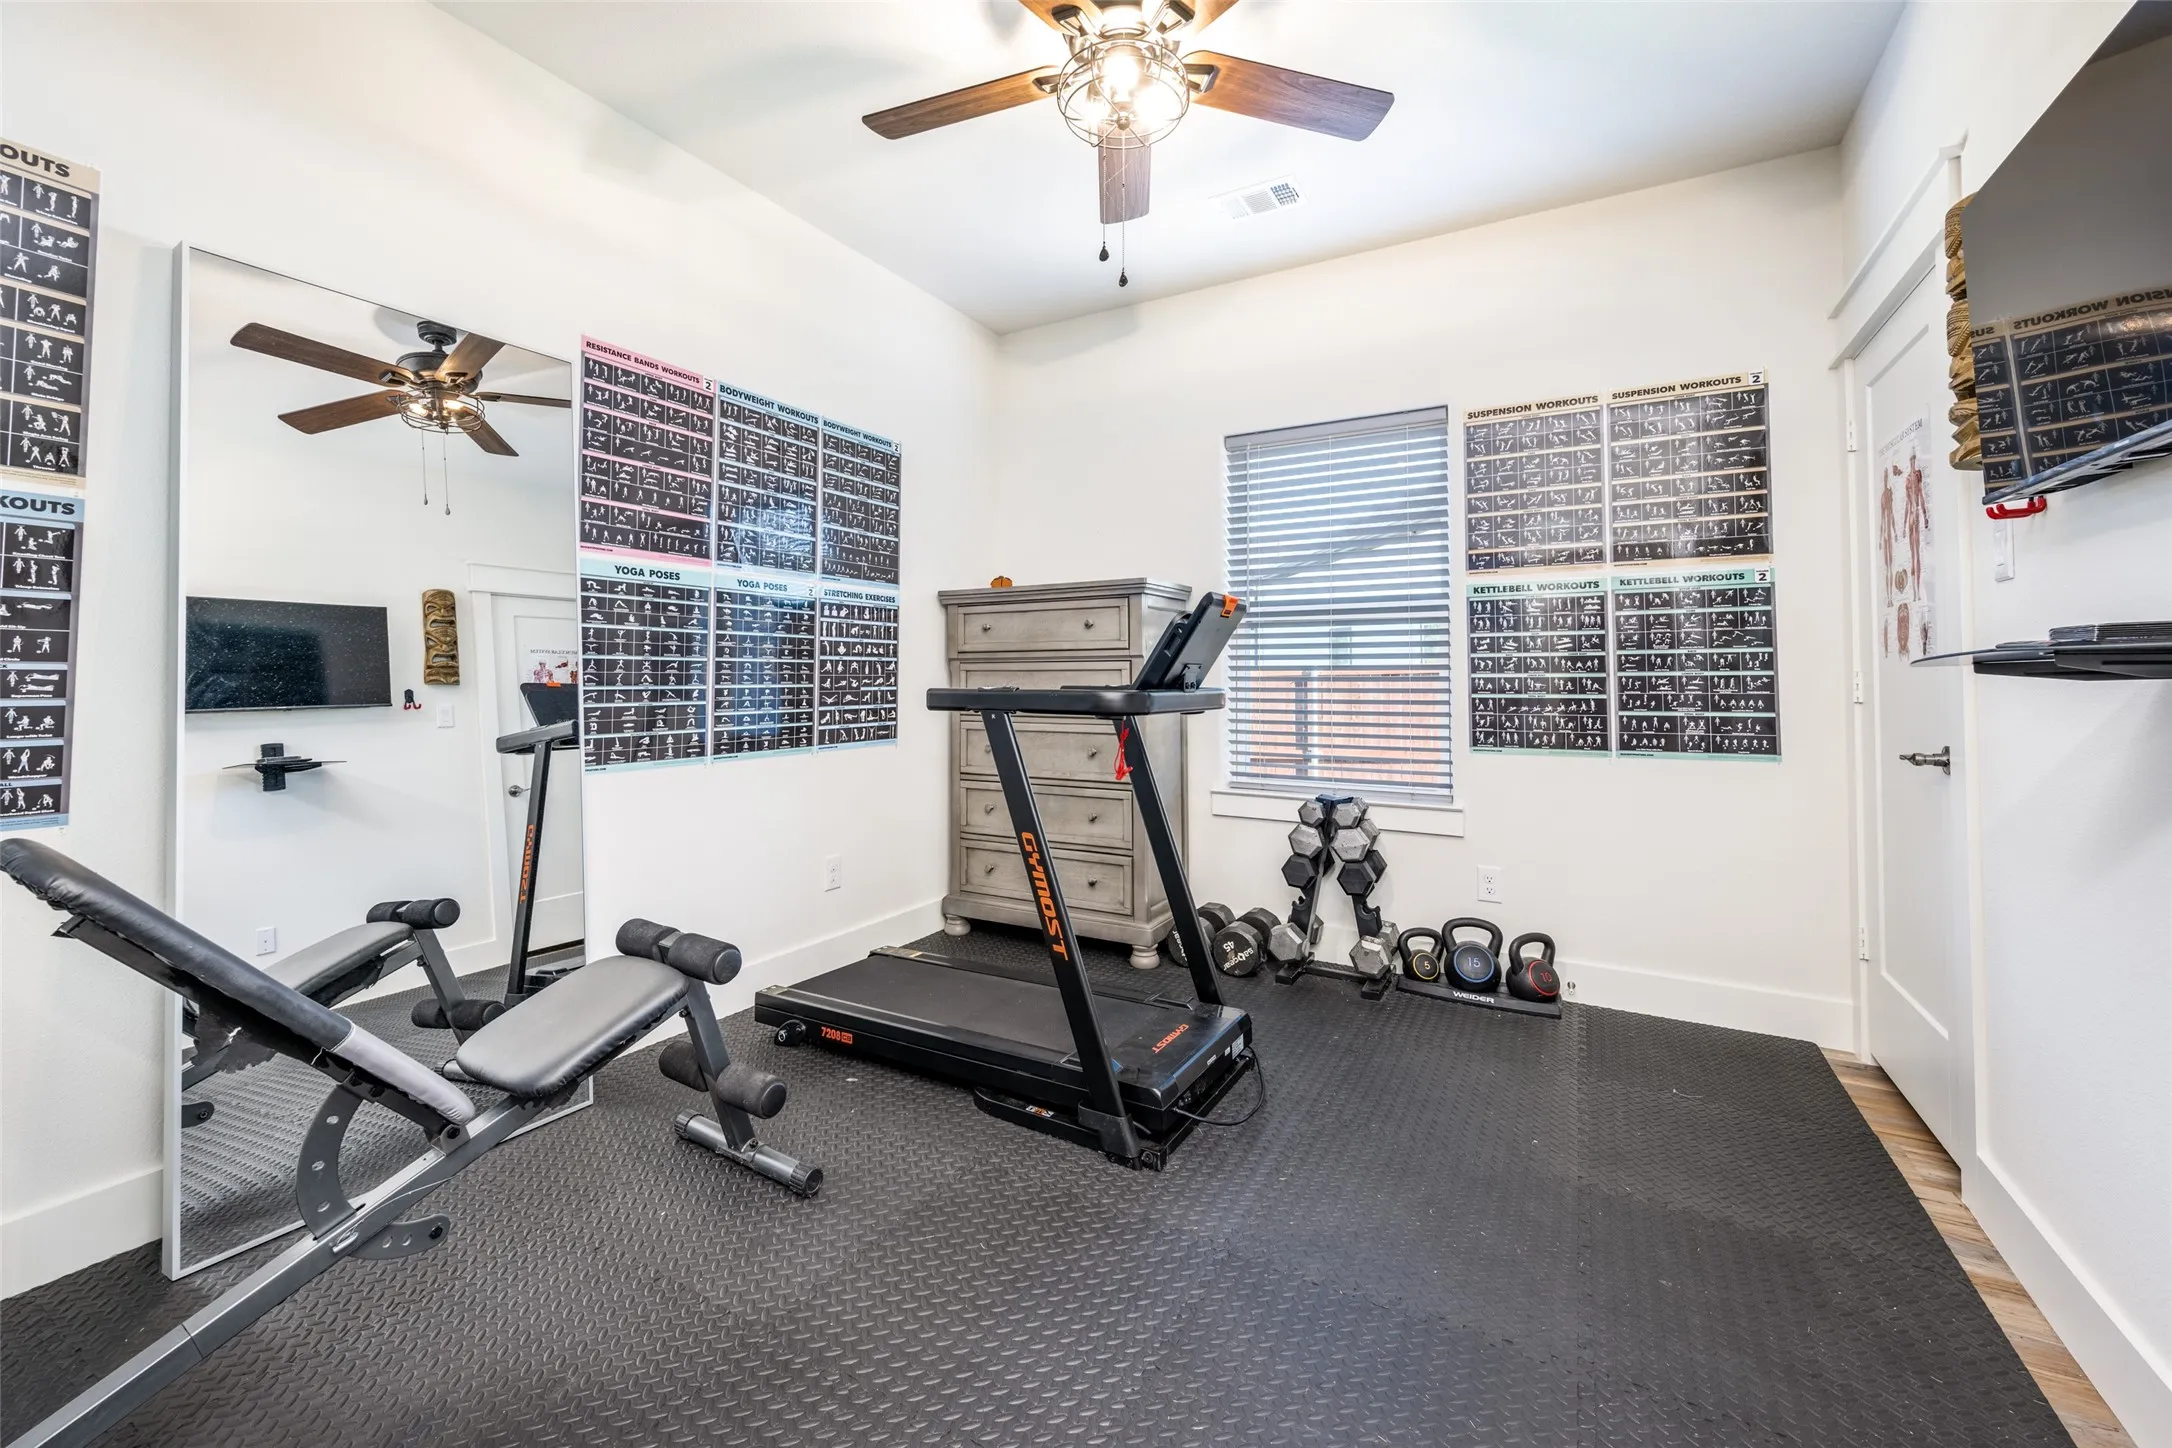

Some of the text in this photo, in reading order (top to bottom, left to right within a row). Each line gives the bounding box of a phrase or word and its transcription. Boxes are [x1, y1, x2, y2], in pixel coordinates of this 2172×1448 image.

[586, 341, 700, 384] RESISTANCE BANDS WORKOUTS
[1752, 375, 1760, 383] 2
[704, 382, 712, 391] 2
[1612, 376, 1742, 400] SUSPENSION WORKOUTS
[720, 384, 818, 424] BODYWEIGHT WORKOUTS
[1468, 395, 1598, 419] SUSPENSION WORKOUTS
[823, 420, 892, 448] BODYWEIGHT WORKOUTS
[894, 444, 899, 452] 2
[615, 565, 681, 581] YOGA POSES
[1620, 573, 1745, 586] KETTLEBELL WORKOUTS
[1758, 573, 1767, 581] 2
[737, 579, 788, 592] YOGA POSES
[1473, 581, 1600, 594] KETTLEBELL WORKOUTS
[824, 589, 896, 603] STRETCHING EXERCISES
[1021, 831, 1069, 961] GYMOST
[1223, 941, 1235, 953] 45
[1424, 961, 1431, 970] 5
[1468, 957, 1480, 968] 15
[1540, 972, 1553, 982] 10
[1452, 990, 1495, 1003] WEIDER
[821, 1026, 840, 1040] 7208
[1152, 1024, 1190, 1054] GYMOST
